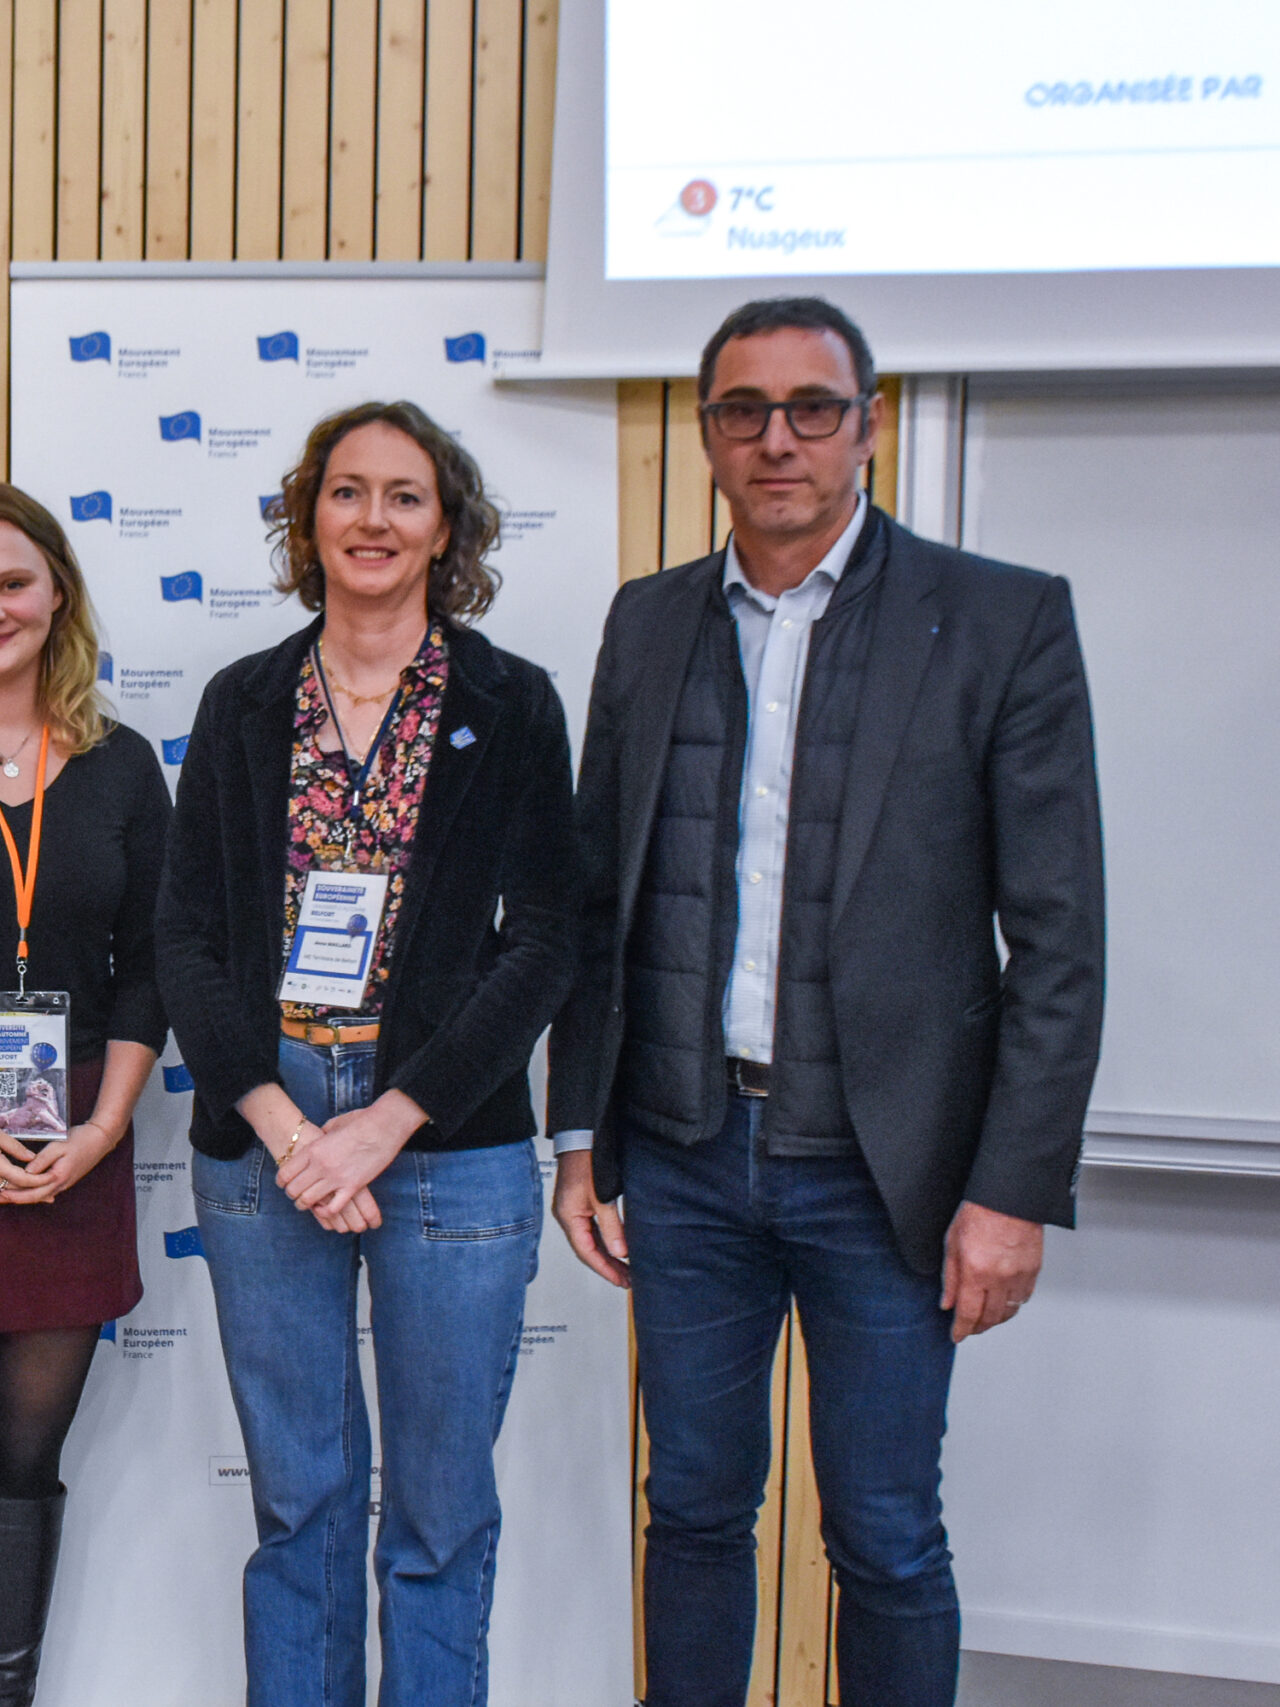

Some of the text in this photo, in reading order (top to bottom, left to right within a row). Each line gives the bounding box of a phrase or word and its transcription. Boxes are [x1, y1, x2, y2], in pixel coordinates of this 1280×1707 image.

[1024, 73, 1262, 108] ORGANISÉE PAR
[728, 187, 774, 211] 7°C
[727, 227, 846, 254] Nuageux
[118, 348, 180, 357] Mouvement
[306, 348, 368, 357] Mouvement
[118, 359, 168, 369] Européen
[306, 359, 356, 369] Européen
[306, 371, 336, 379] France
[208, 428, 271, 437] Mouvement
[208, 439, 258, 449] Européen
[208, 450, 238, 458] France
[119, 507, 182, 517] Mouvement
[119, 519, 169, 529] Européen
[119, 530, 150, 538] France
[210, 588, 272, 597] Mouvement
[210, 599, 260, 609] Européen
[210, 611, 239, 619] France
[120, 668, 183, 678] Mouvement
[120, 680, 170, 690] Européen
[120, 692, 150, 700] France
[133, 1162, 186, 1170] ouvement
[135, 1171, 173, 1183] ropéen
[123, 1327, 187, 1337] Mouvement
[123, 1338, 174, 1348] Européen
[523, 1335, 554, 1345] opéen
[123, 1350, 153, 1359] France
